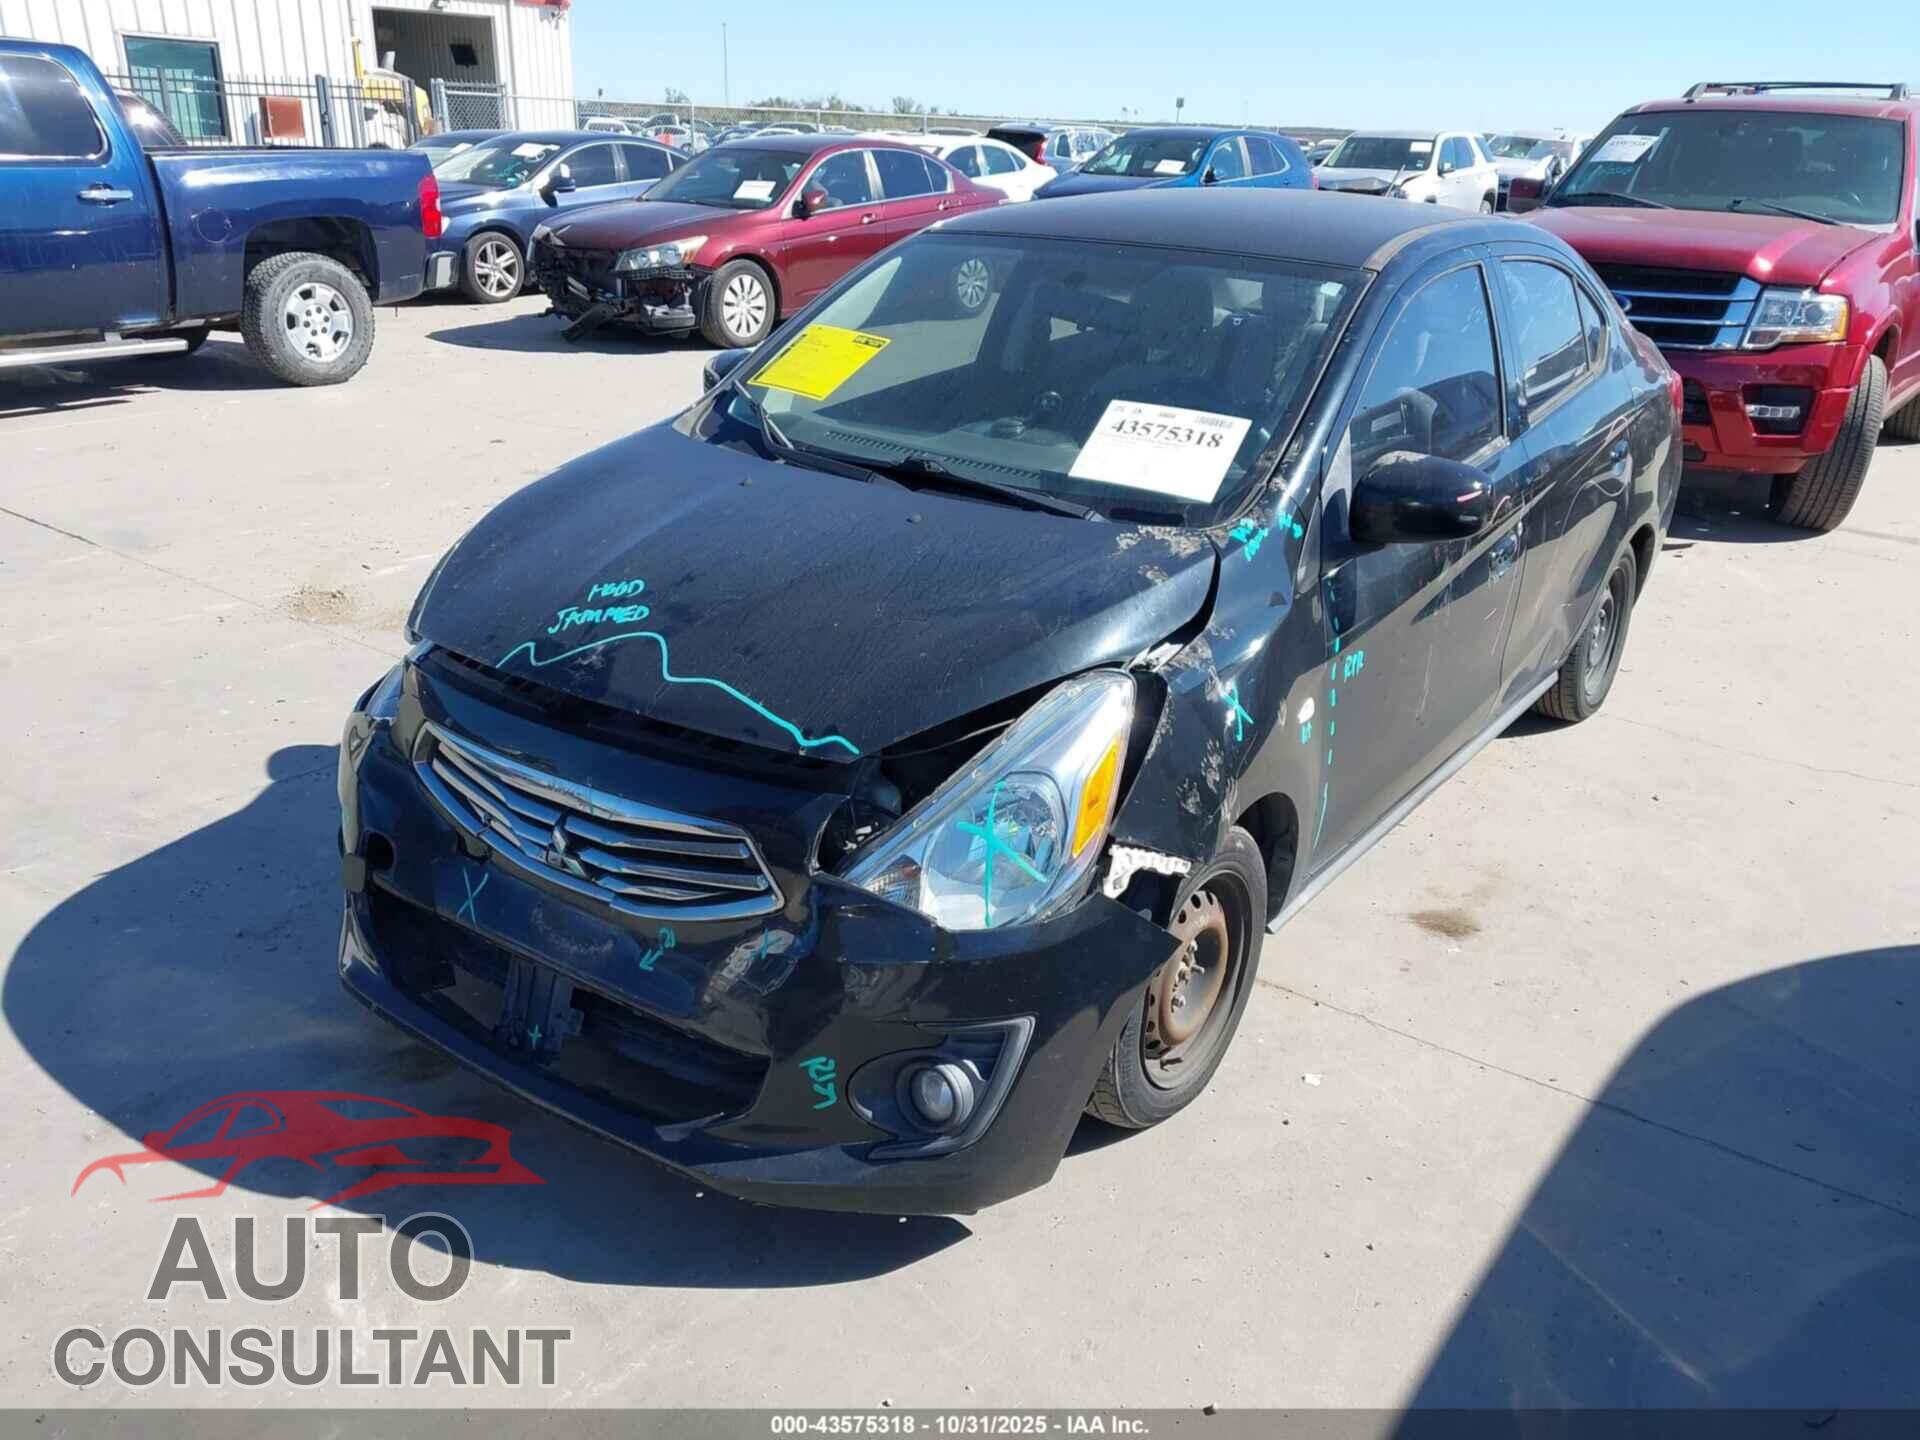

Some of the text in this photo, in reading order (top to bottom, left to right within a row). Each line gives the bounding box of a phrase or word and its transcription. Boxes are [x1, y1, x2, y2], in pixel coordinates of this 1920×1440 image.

[1111, 418, 1225, 449] 43575318
[587, 579, 645, 602] HOOD
[547, 604, 650, 634] JAMMED
